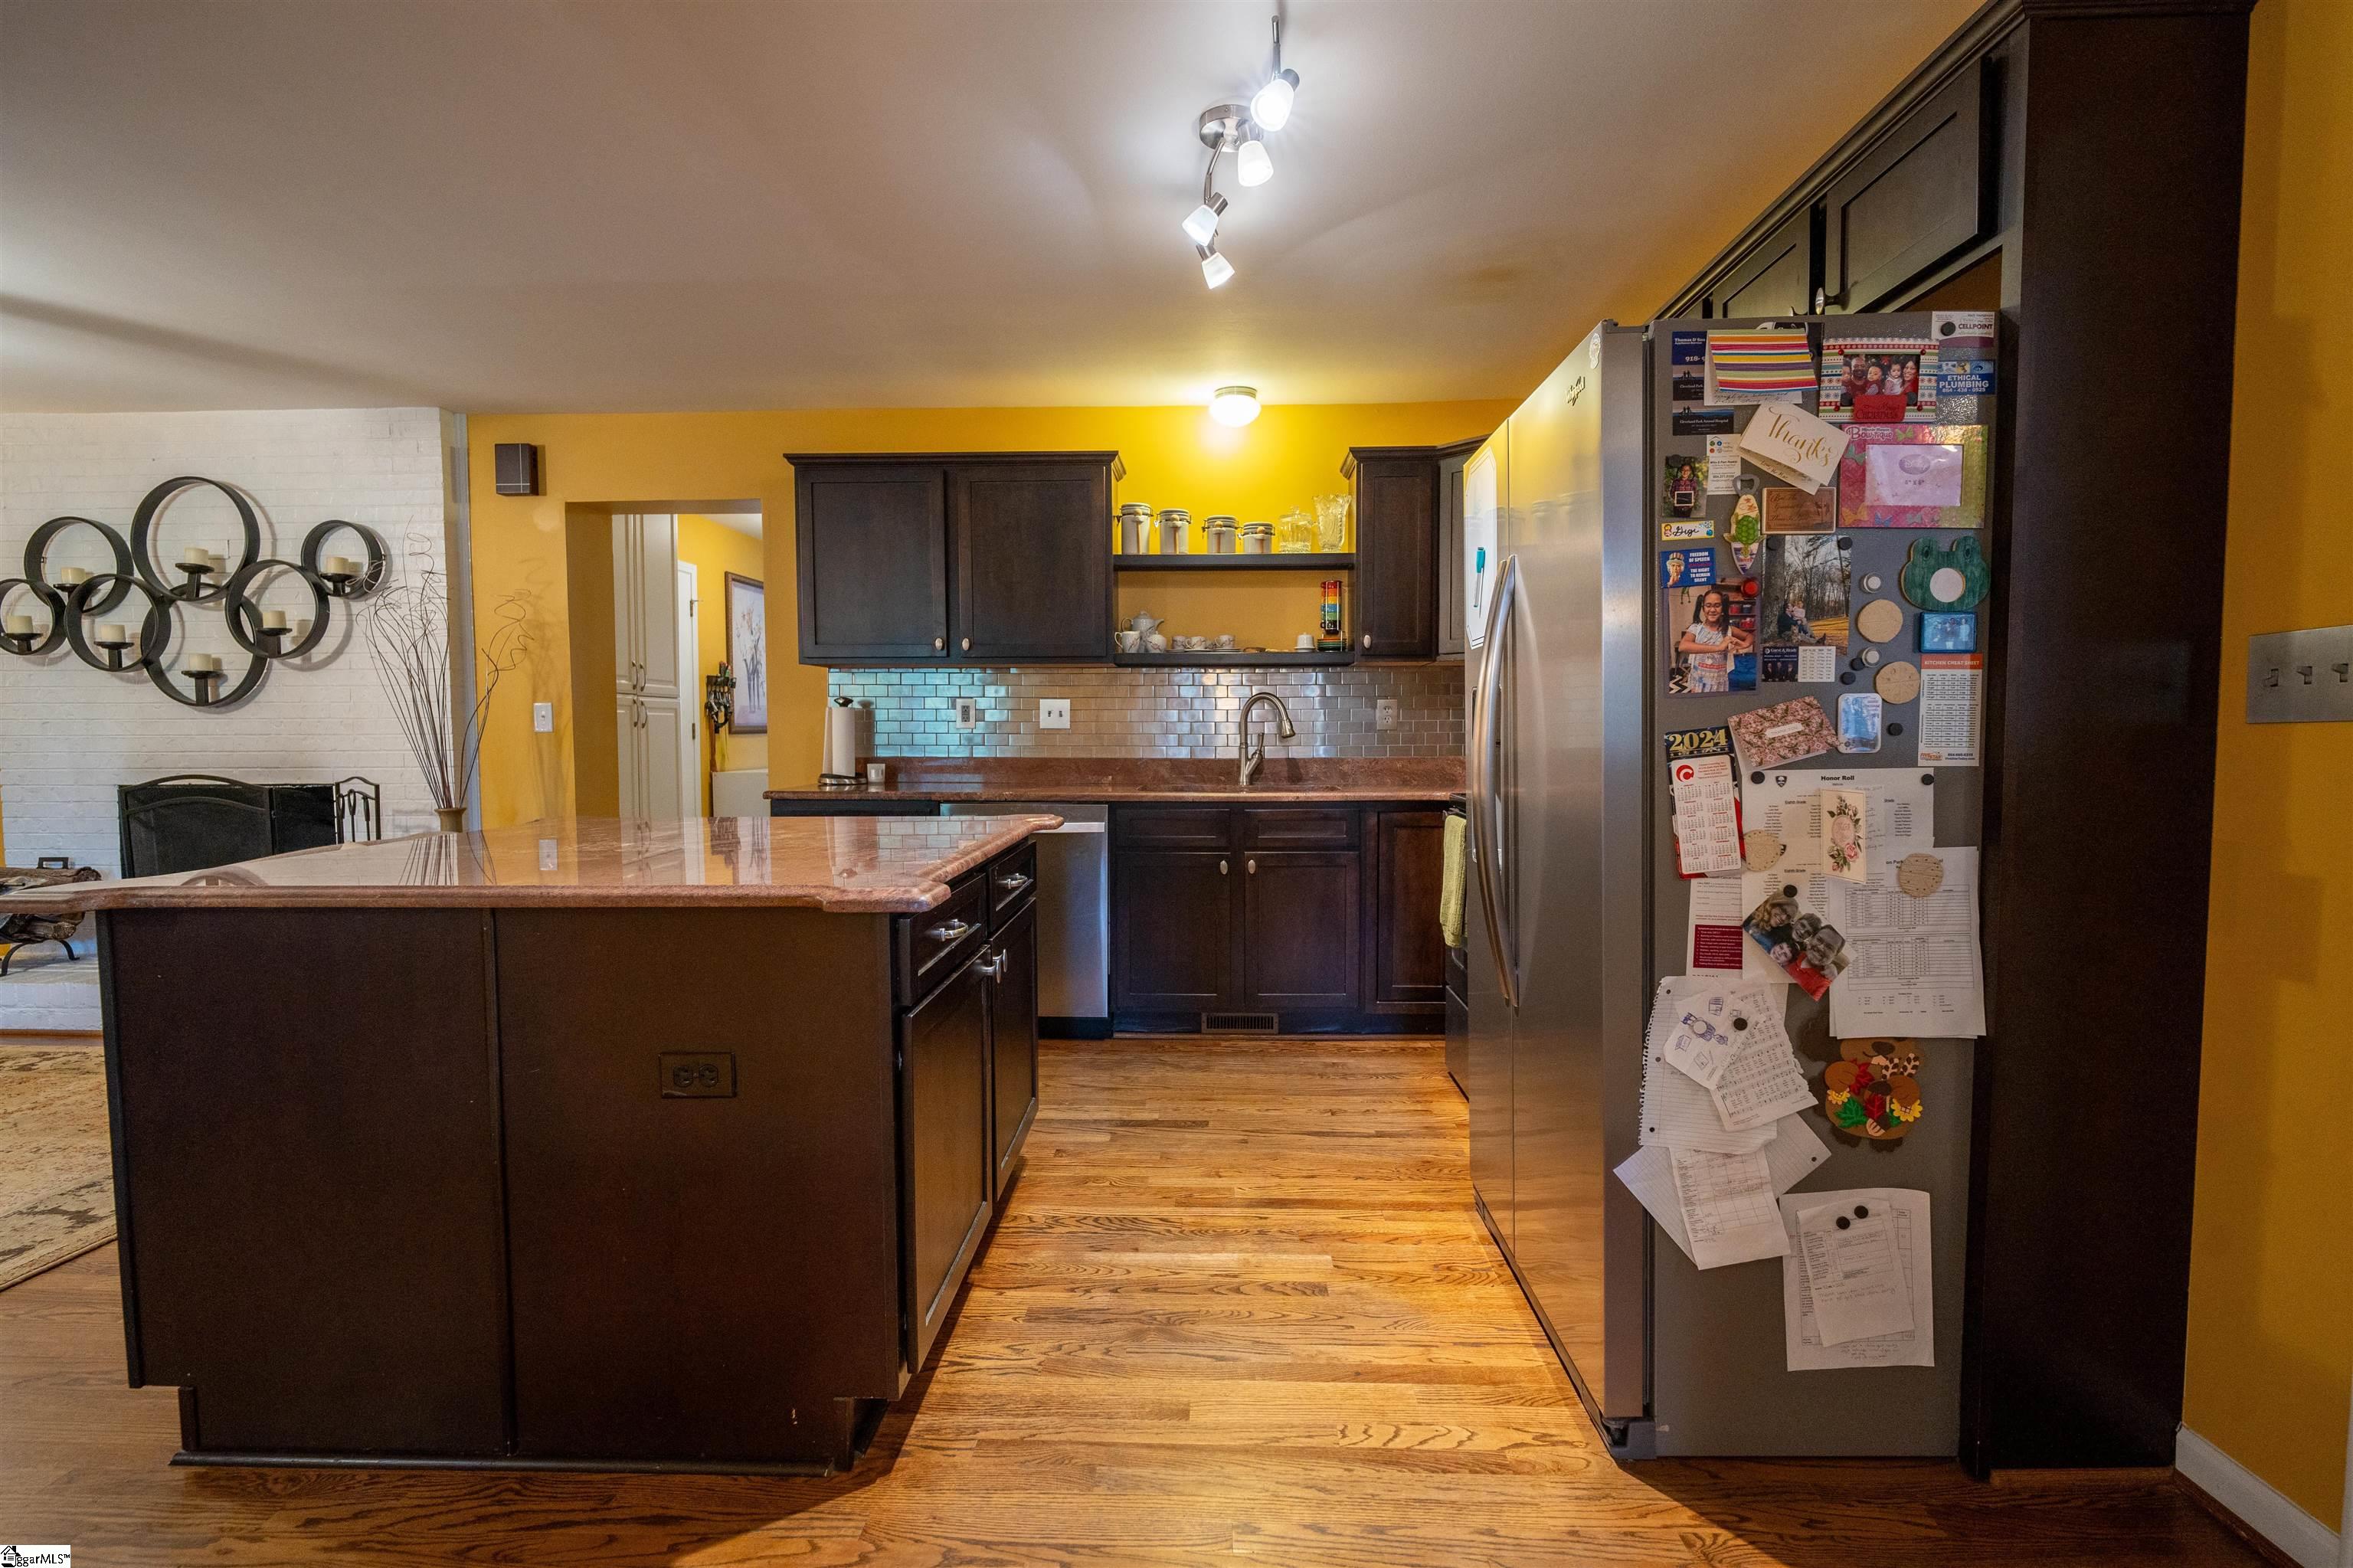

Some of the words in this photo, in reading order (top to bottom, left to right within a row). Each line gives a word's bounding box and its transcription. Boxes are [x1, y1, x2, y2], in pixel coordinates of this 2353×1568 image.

[1939, 380, 1989, 388] PLUMBING
[1769, 406, 1838, 467] Thanks
[1669, 728, 1728, 751] 2024
